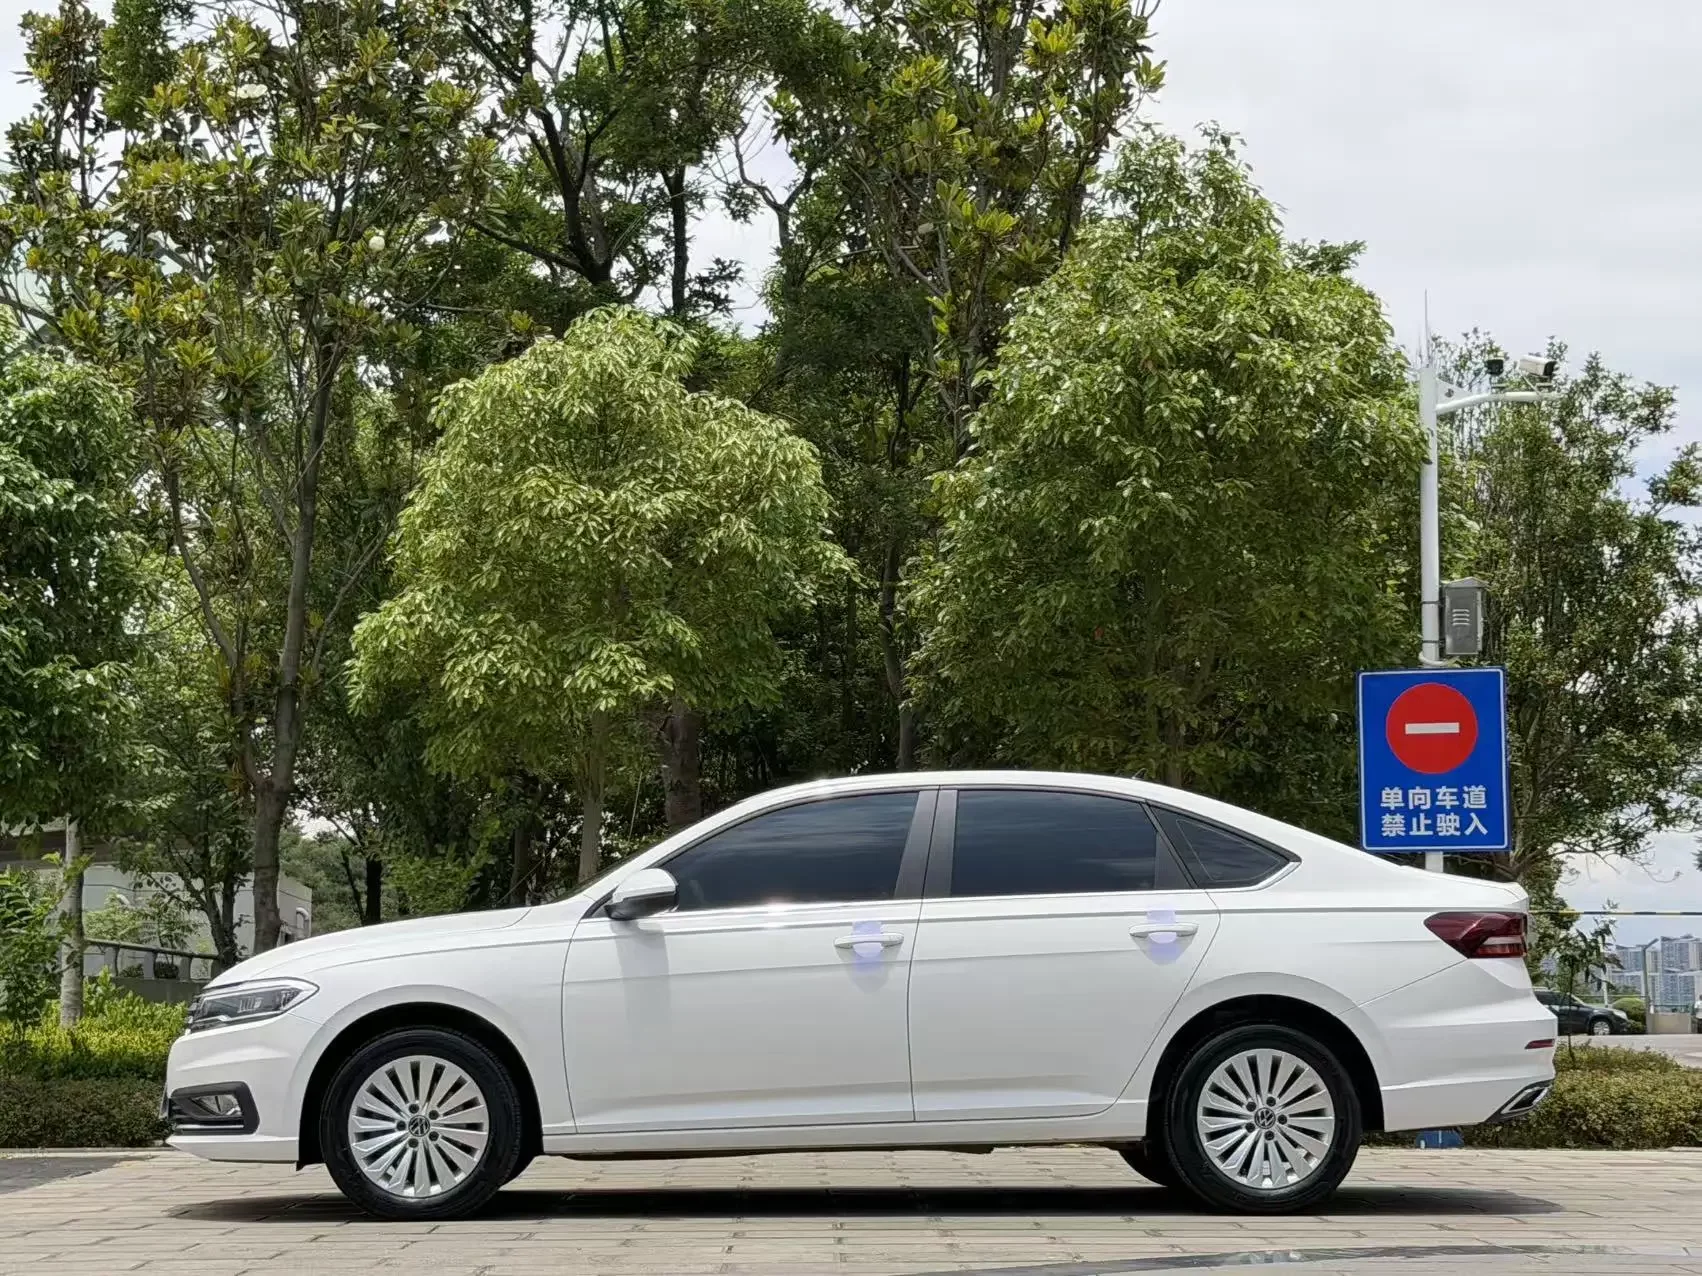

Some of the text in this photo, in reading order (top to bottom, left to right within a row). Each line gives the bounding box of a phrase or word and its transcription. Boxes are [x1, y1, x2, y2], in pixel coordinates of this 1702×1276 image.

[1380, 785, 1487, 810] 单向车道
[1381, 812, 1488, 836] 禁止驶入
